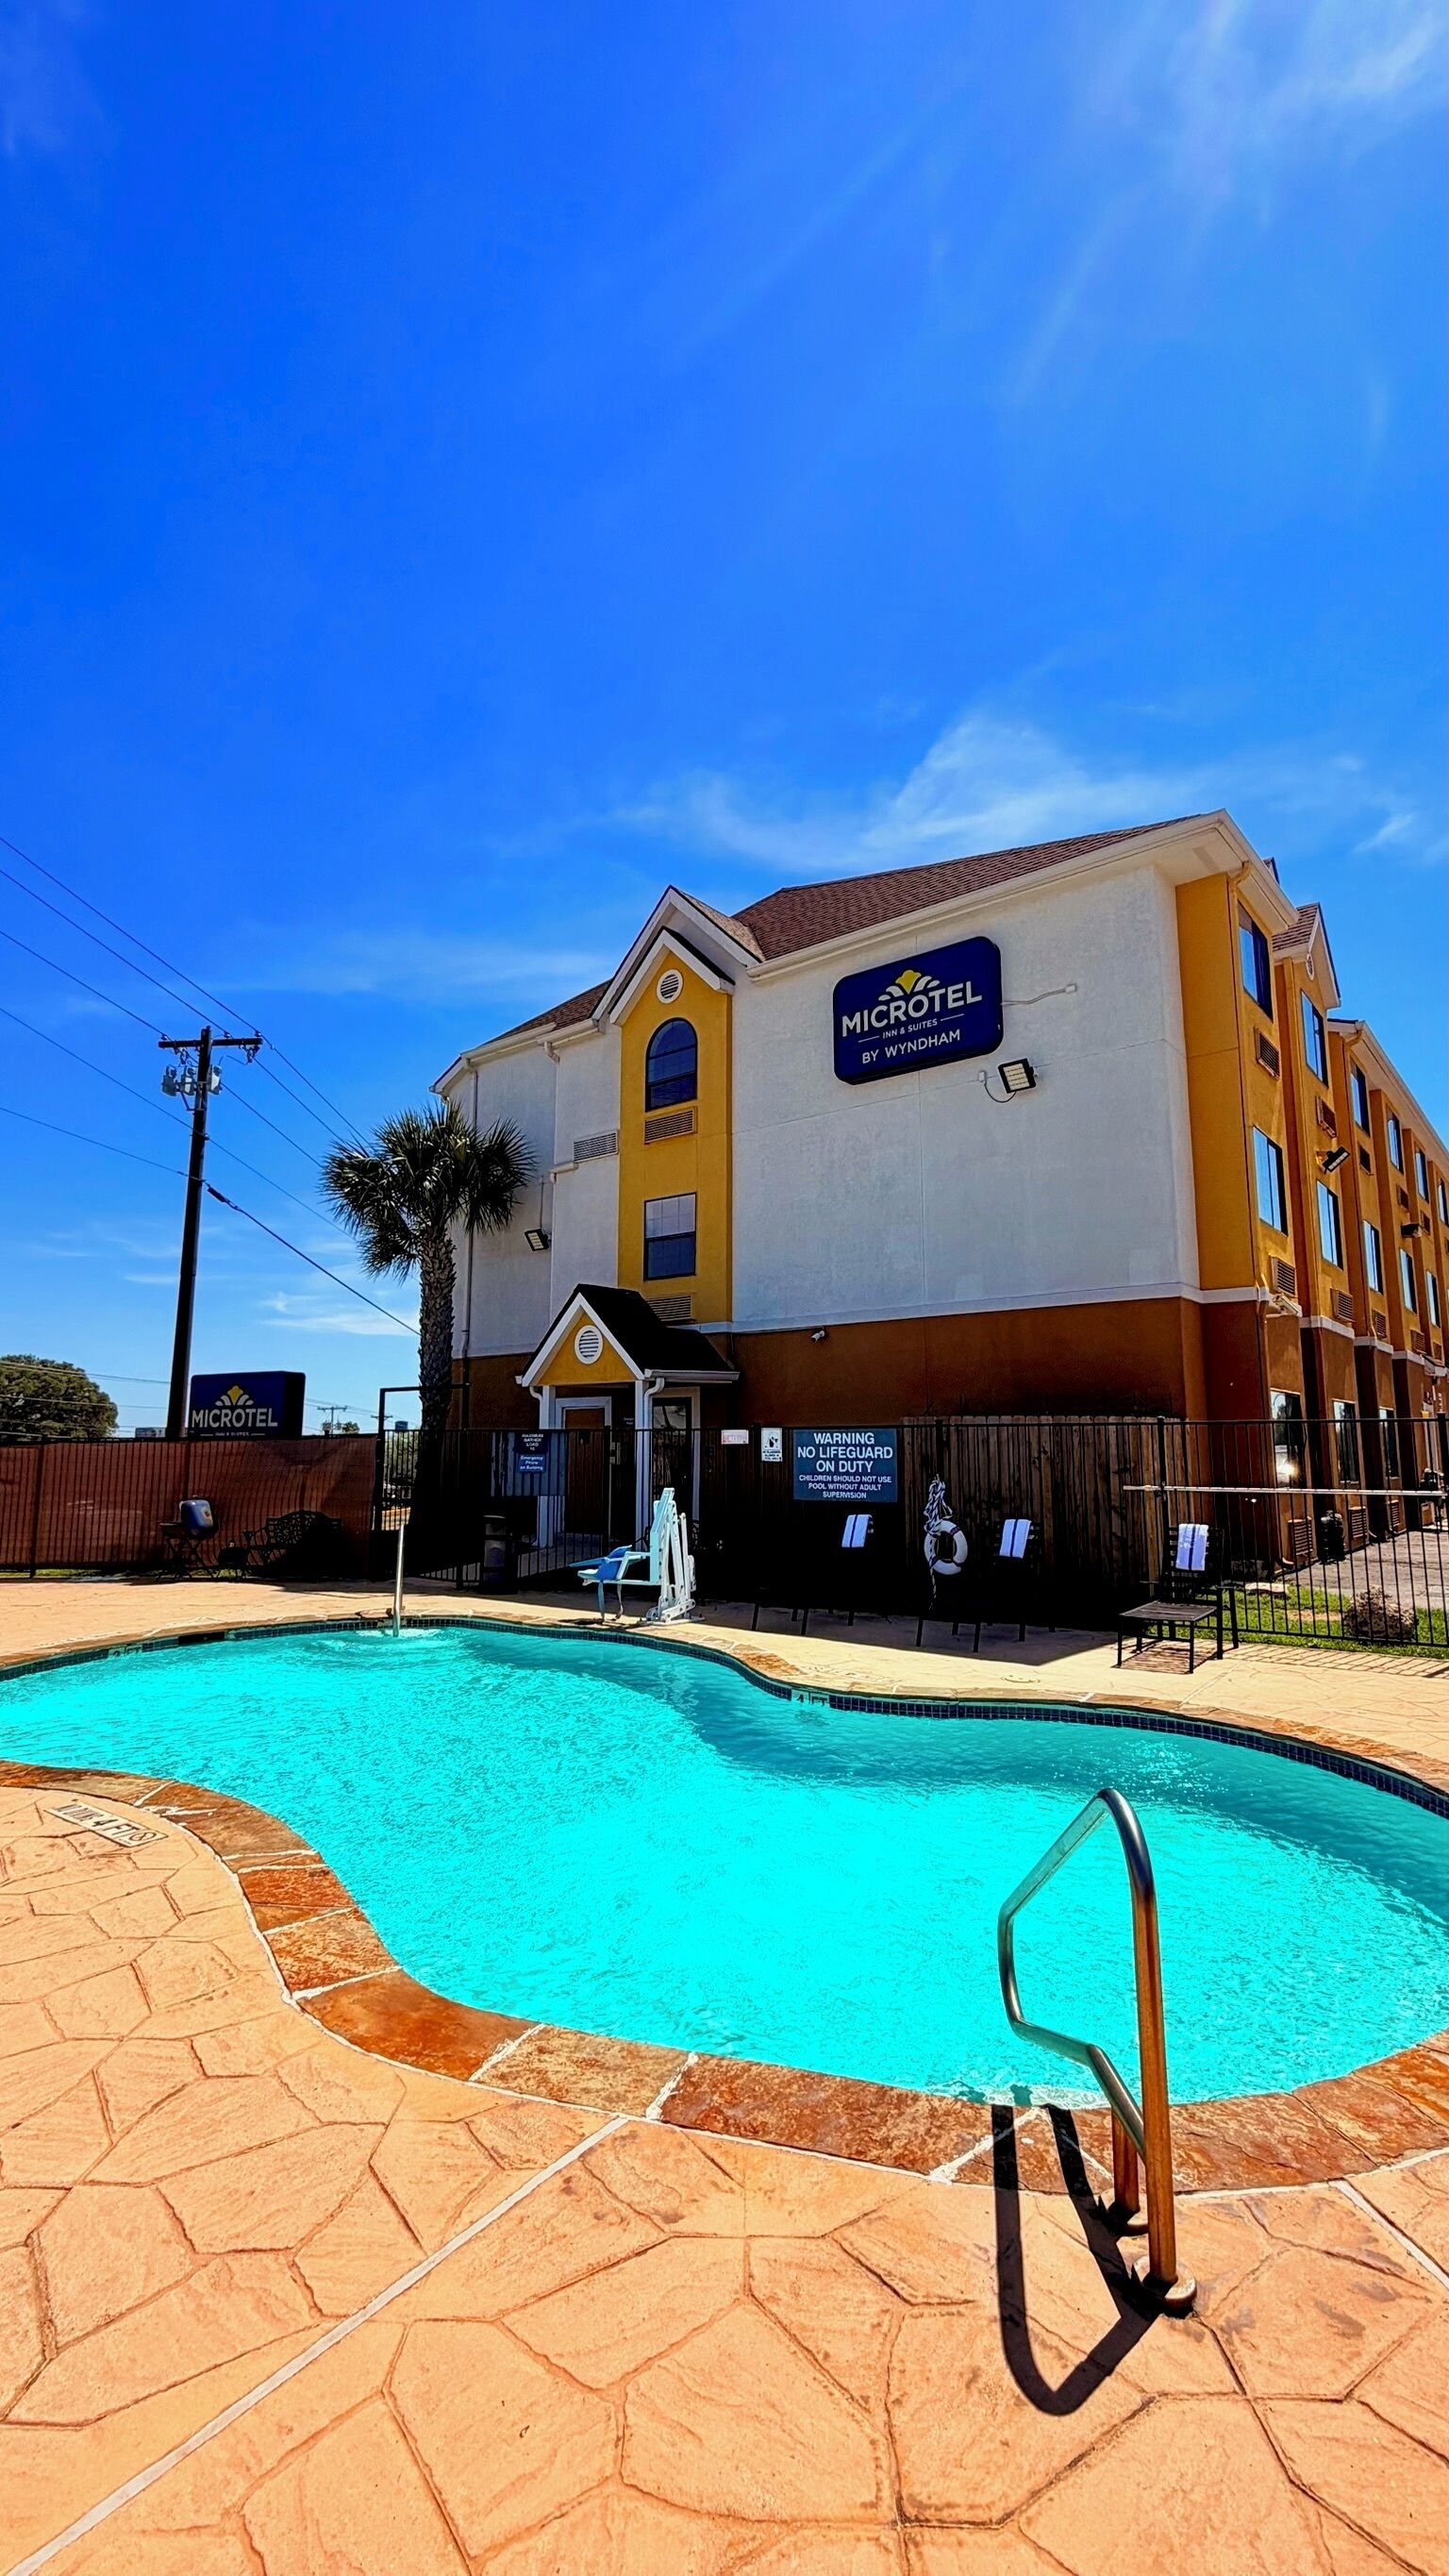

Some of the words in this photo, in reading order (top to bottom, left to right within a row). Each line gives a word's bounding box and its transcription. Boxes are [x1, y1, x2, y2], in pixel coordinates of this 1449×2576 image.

[841, 980, 983, 1037] MICROTEL
[882, 1030, 898, 1039] INN
[899, 1027, 906, 1035] &
[908, 1018, 938, 1032] SUITES
[862, 1049, 880, 1064] BY
[884, 1029, 960, 1058] WYNDHAM
[192, 1408, 278, 1428] MICROTEL
[813, 1431, 874, 1445] WARNING
[797, 1447, 816, 1458] NO
[819, 1447, 893, 1459] LIFEGUARD
[816, 1460, 835, 1472] ON
[839, 1460, 874, 1473] DUTY
[823, 1491, 867, 1499] SUPERVISION
[92, 1818, 119, 1827] 4
[102, 1823, 141, 1835] FT
